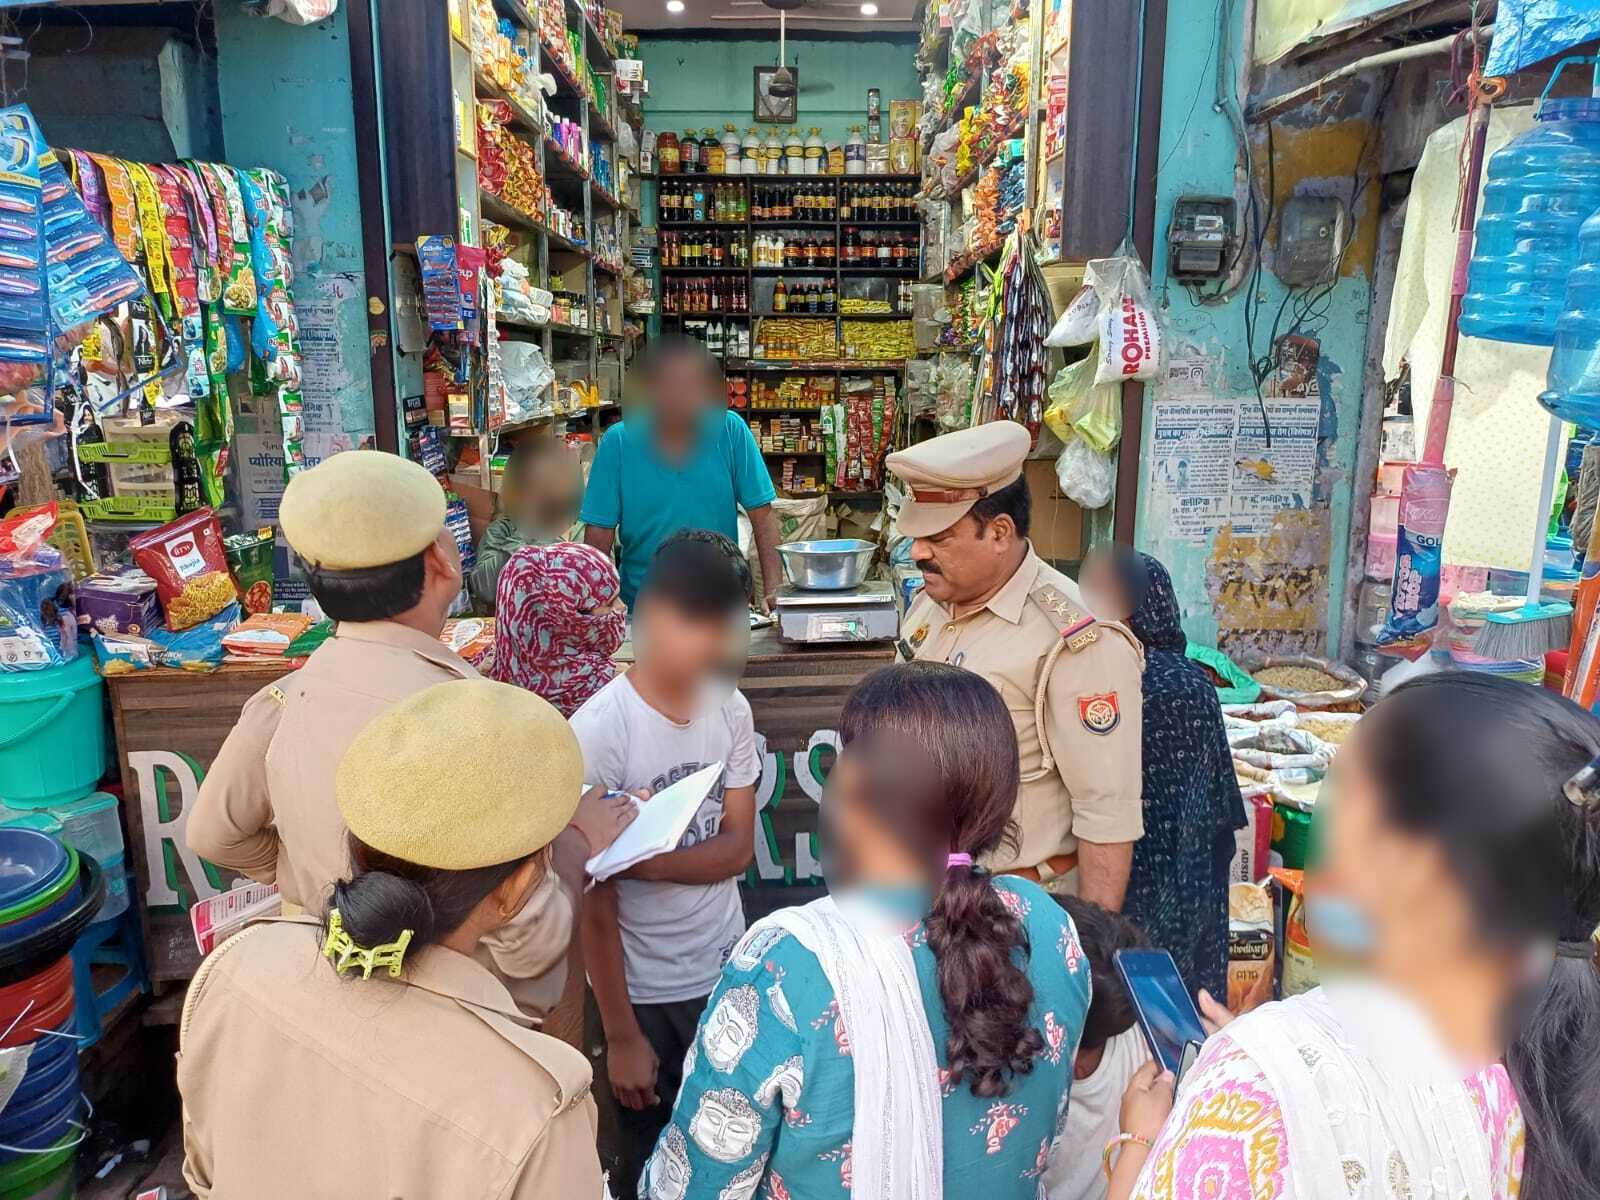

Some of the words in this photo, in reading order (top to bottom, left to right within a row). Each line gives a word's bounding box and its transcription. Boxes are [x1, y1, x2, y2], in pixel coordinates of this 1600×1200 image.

[1121, 297, 1143, 375] ROHAN
[1138, 311, 1151, 360] PREMIUM
[1416, 534, 1442, 546] GOL
